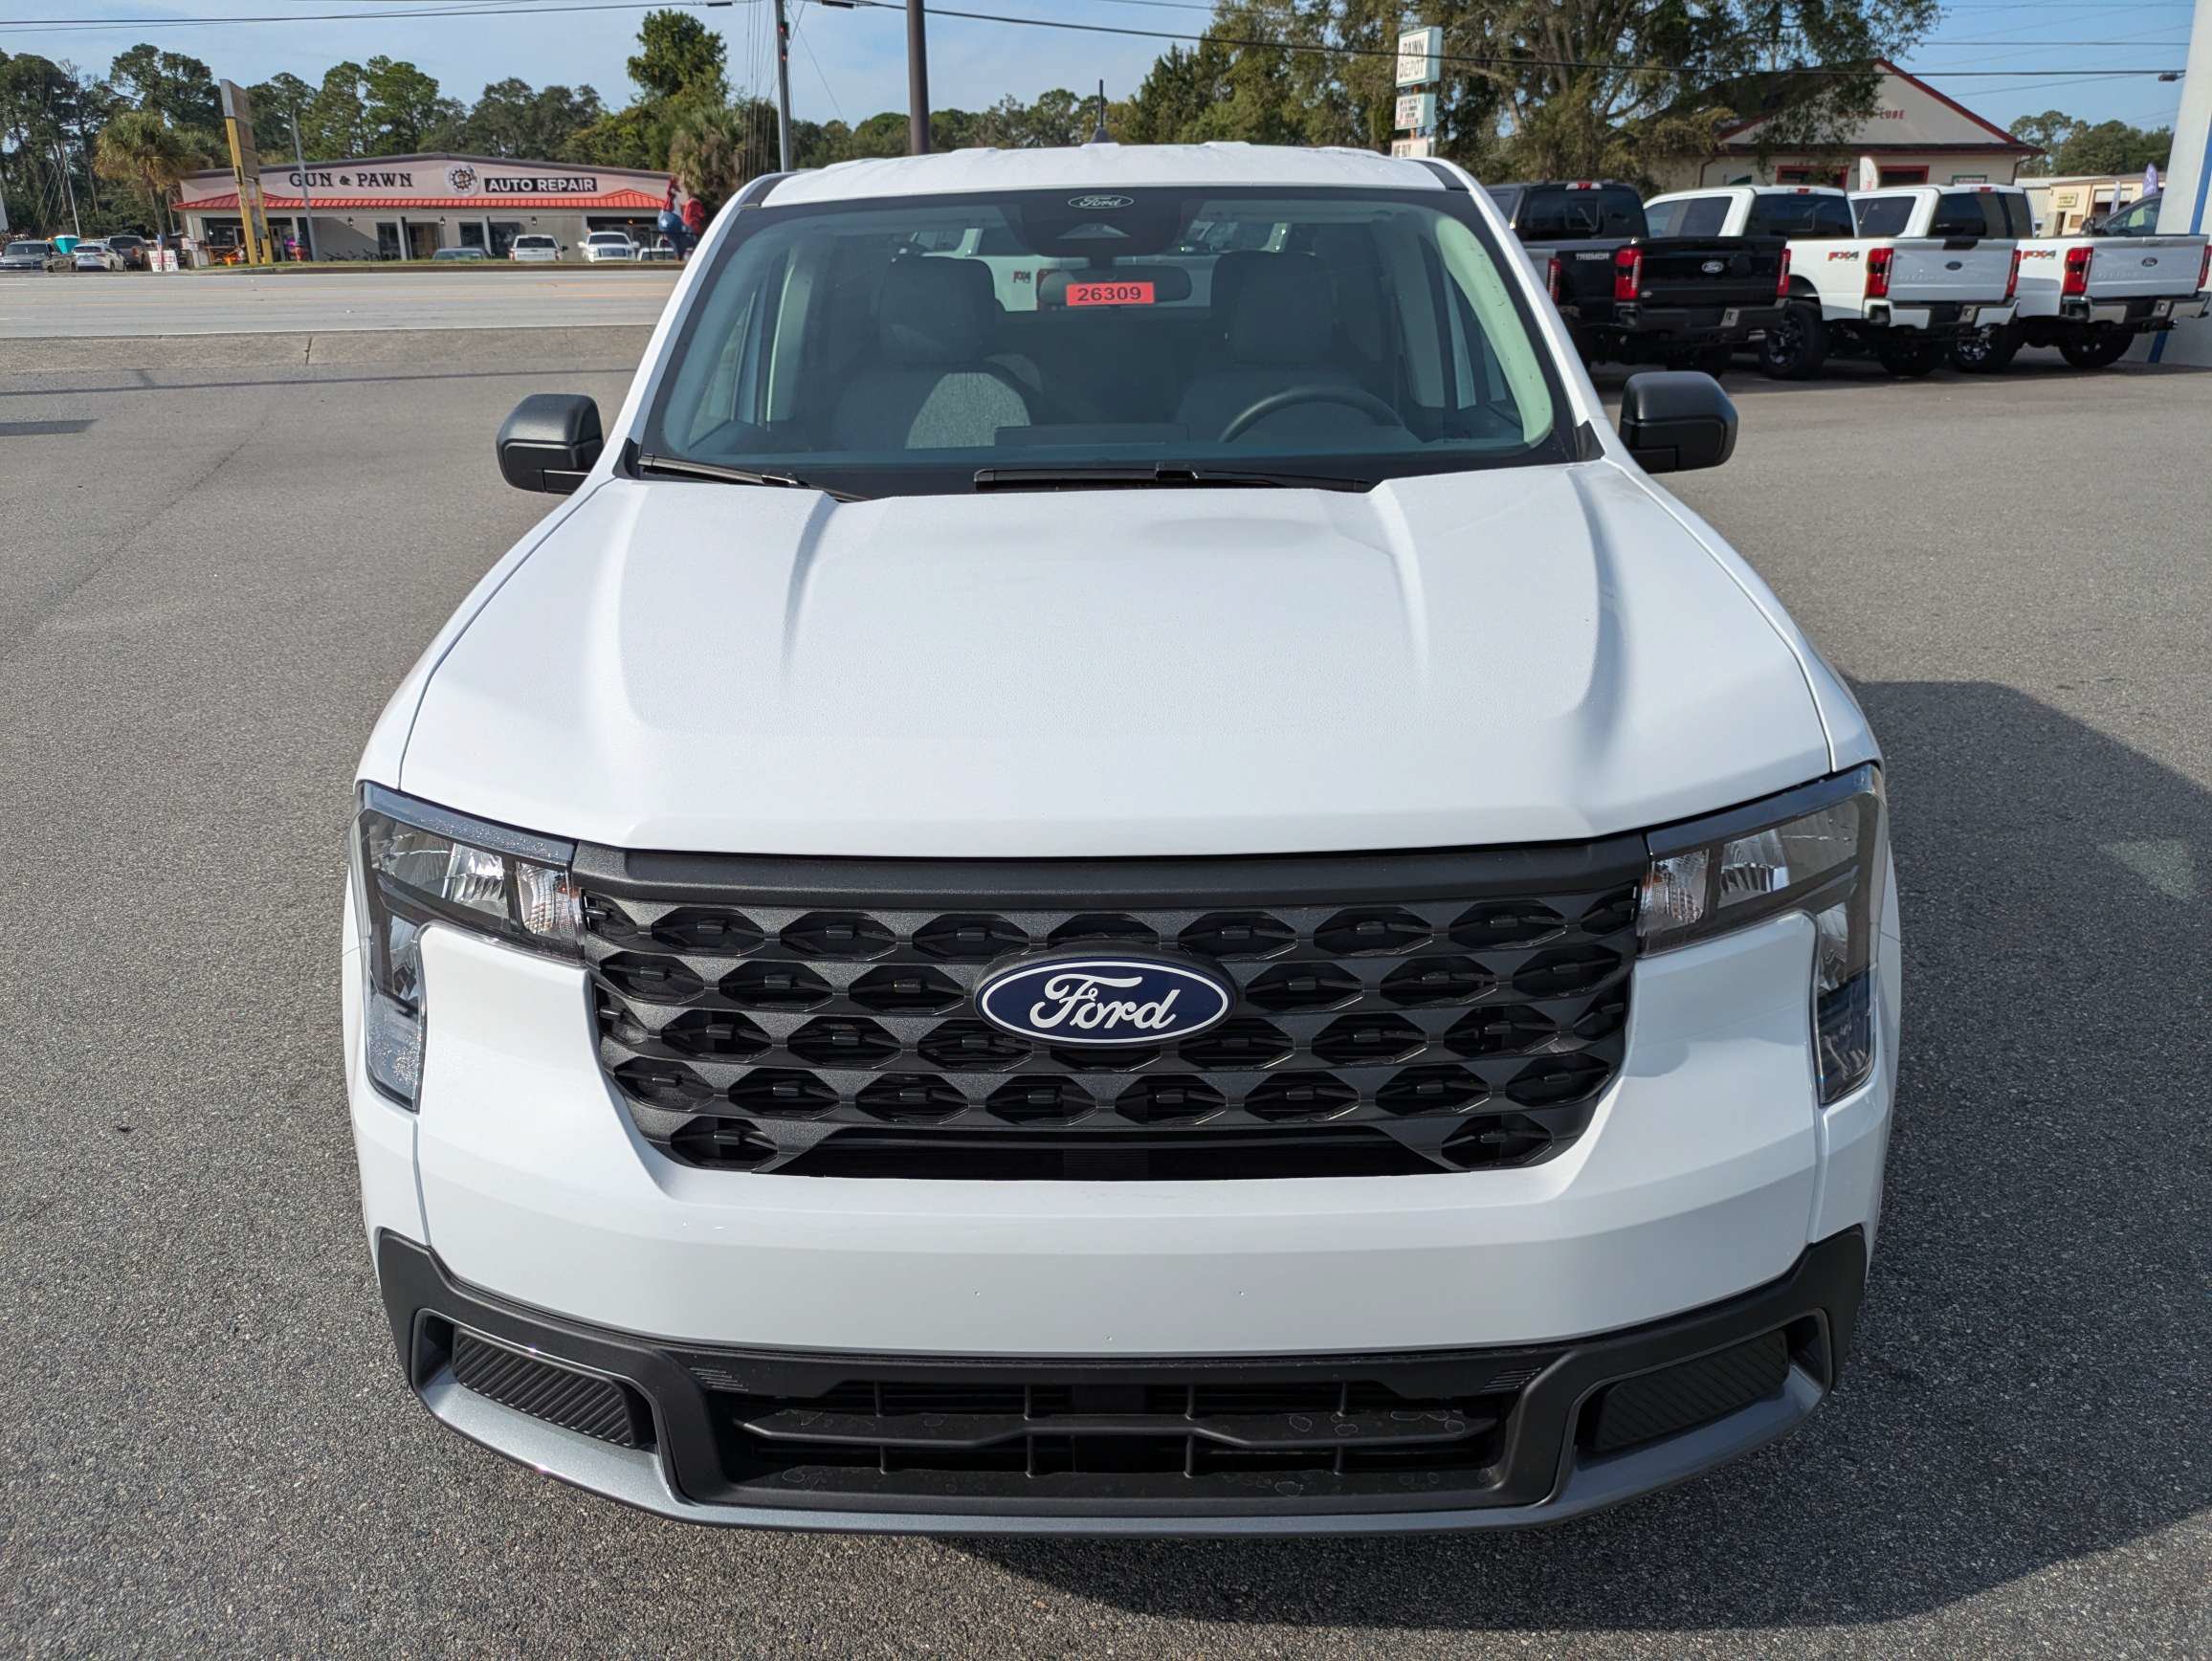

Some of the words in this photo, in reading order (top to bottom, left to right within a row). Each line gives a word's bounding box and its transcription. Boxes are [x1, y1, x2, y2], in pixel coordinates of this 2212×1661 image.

[289, 172, 334, 188] GUN
[339, 175, 351, 187] &
[356, 172, 413, 188] PAWN
[488, 178, 533, 191] AUTO
[537, 178, 594, 191] REPAIR
[1079, 195, 1123, 207] Ford
[1828, 251, 1859, 261] FX4
[2023, 250, 2056, 260] FX4
[1077, 286, 1141, 301] 26309
[1029, 973, 1182, 1030] Ford
